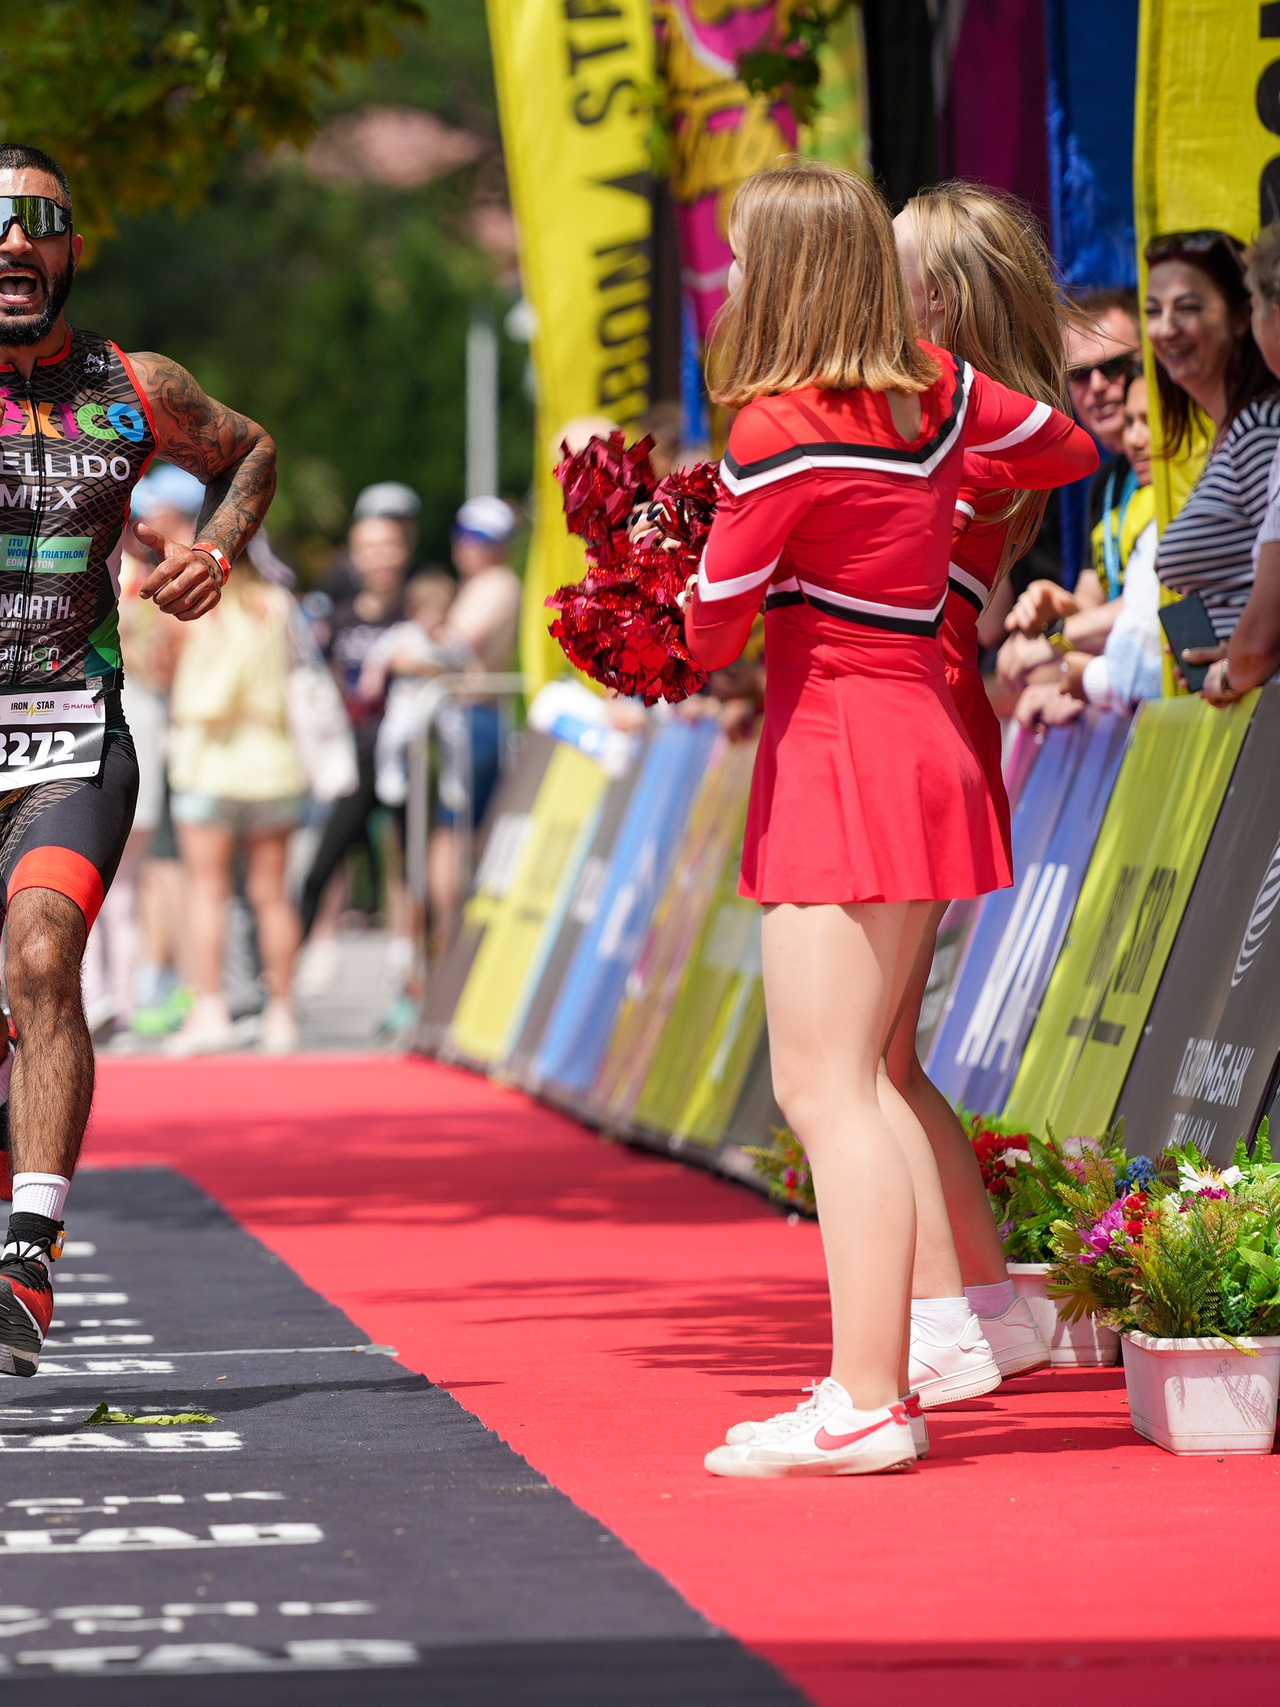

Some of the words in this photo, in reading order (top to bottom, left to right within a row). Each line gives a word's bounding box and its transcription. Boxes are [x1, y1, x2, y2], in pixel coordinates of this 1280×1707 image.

[8, 538, 24, 547] ITU
[41, 550, 85, 559] TRIATHLON
[0, 592, 72, 620] NORTH
[11, 701, 29, 711] IRON
[36, 700, 55, 710] STAR
